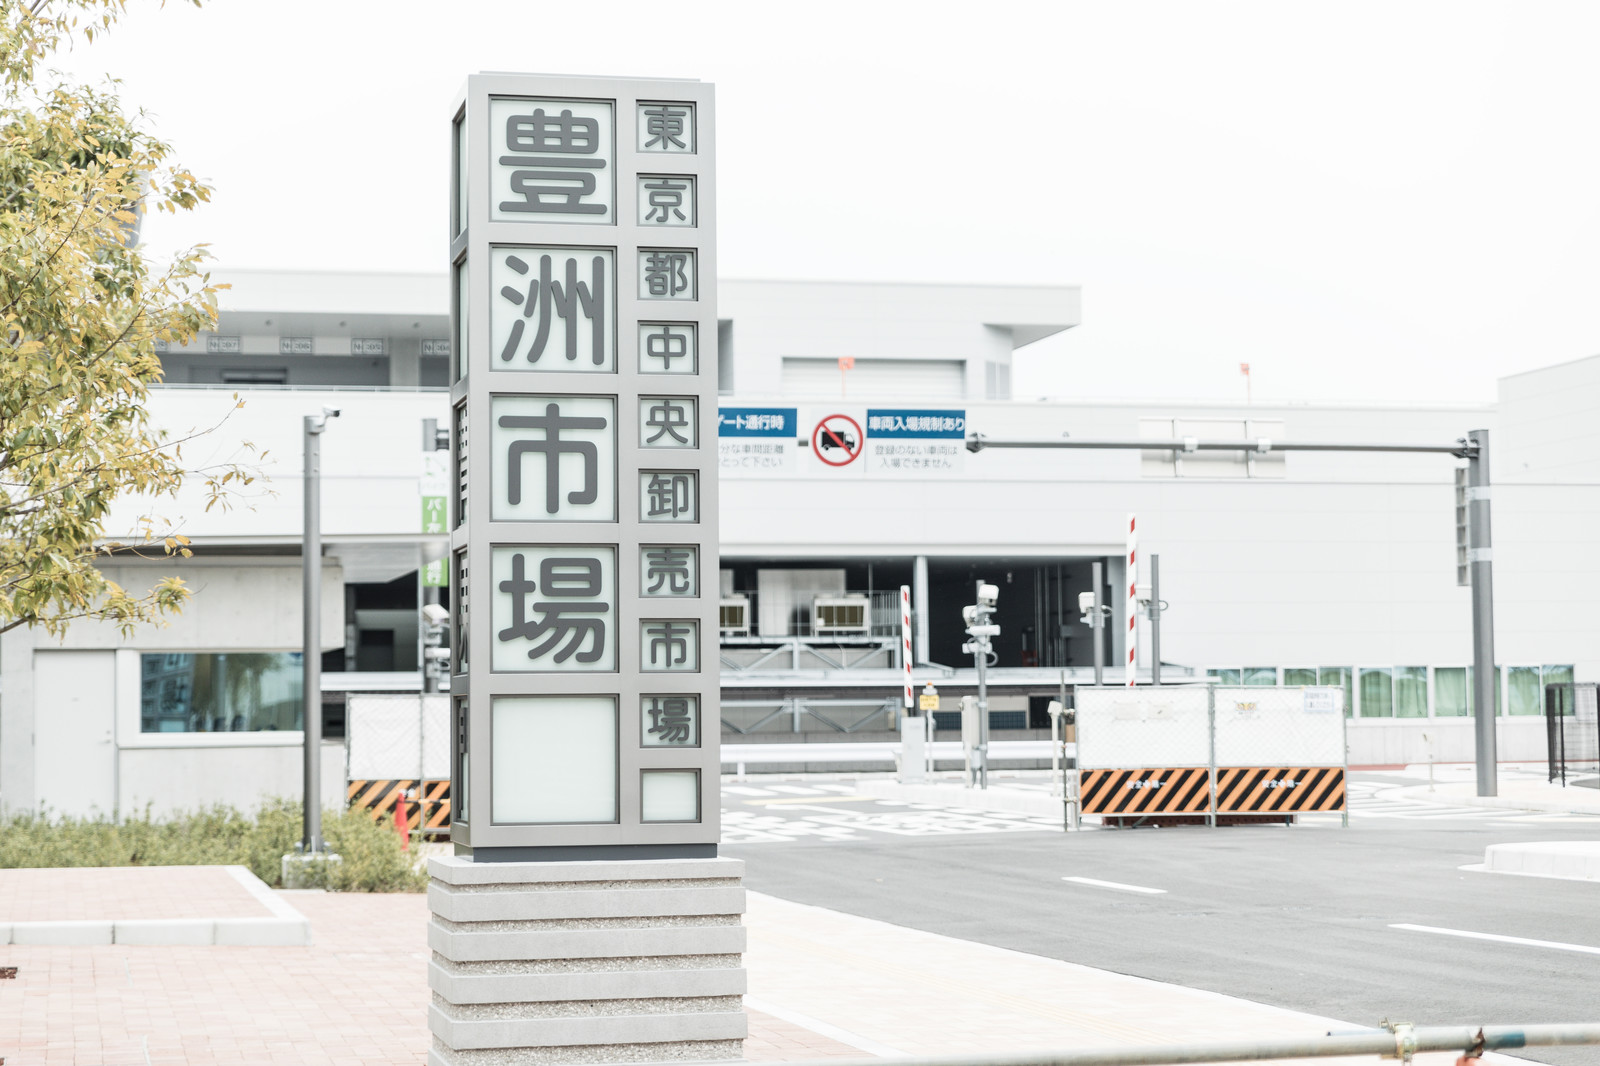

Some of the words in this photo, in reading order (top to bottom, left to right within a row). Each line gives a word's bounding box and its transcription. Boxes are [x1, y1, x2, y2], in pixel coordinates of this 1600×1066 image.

[499, 108, 609, 664] 豊洲市場
[644, 106, 691, 742] 東京都中央卸売市場
[869, 415, 965, 432] 車両入場規制あり
[720, 444, 783, 454] 分な車間距離
[875, 445, 958, 455] 登録のない車両は
[720, 456, 782, 467] とって下さい
